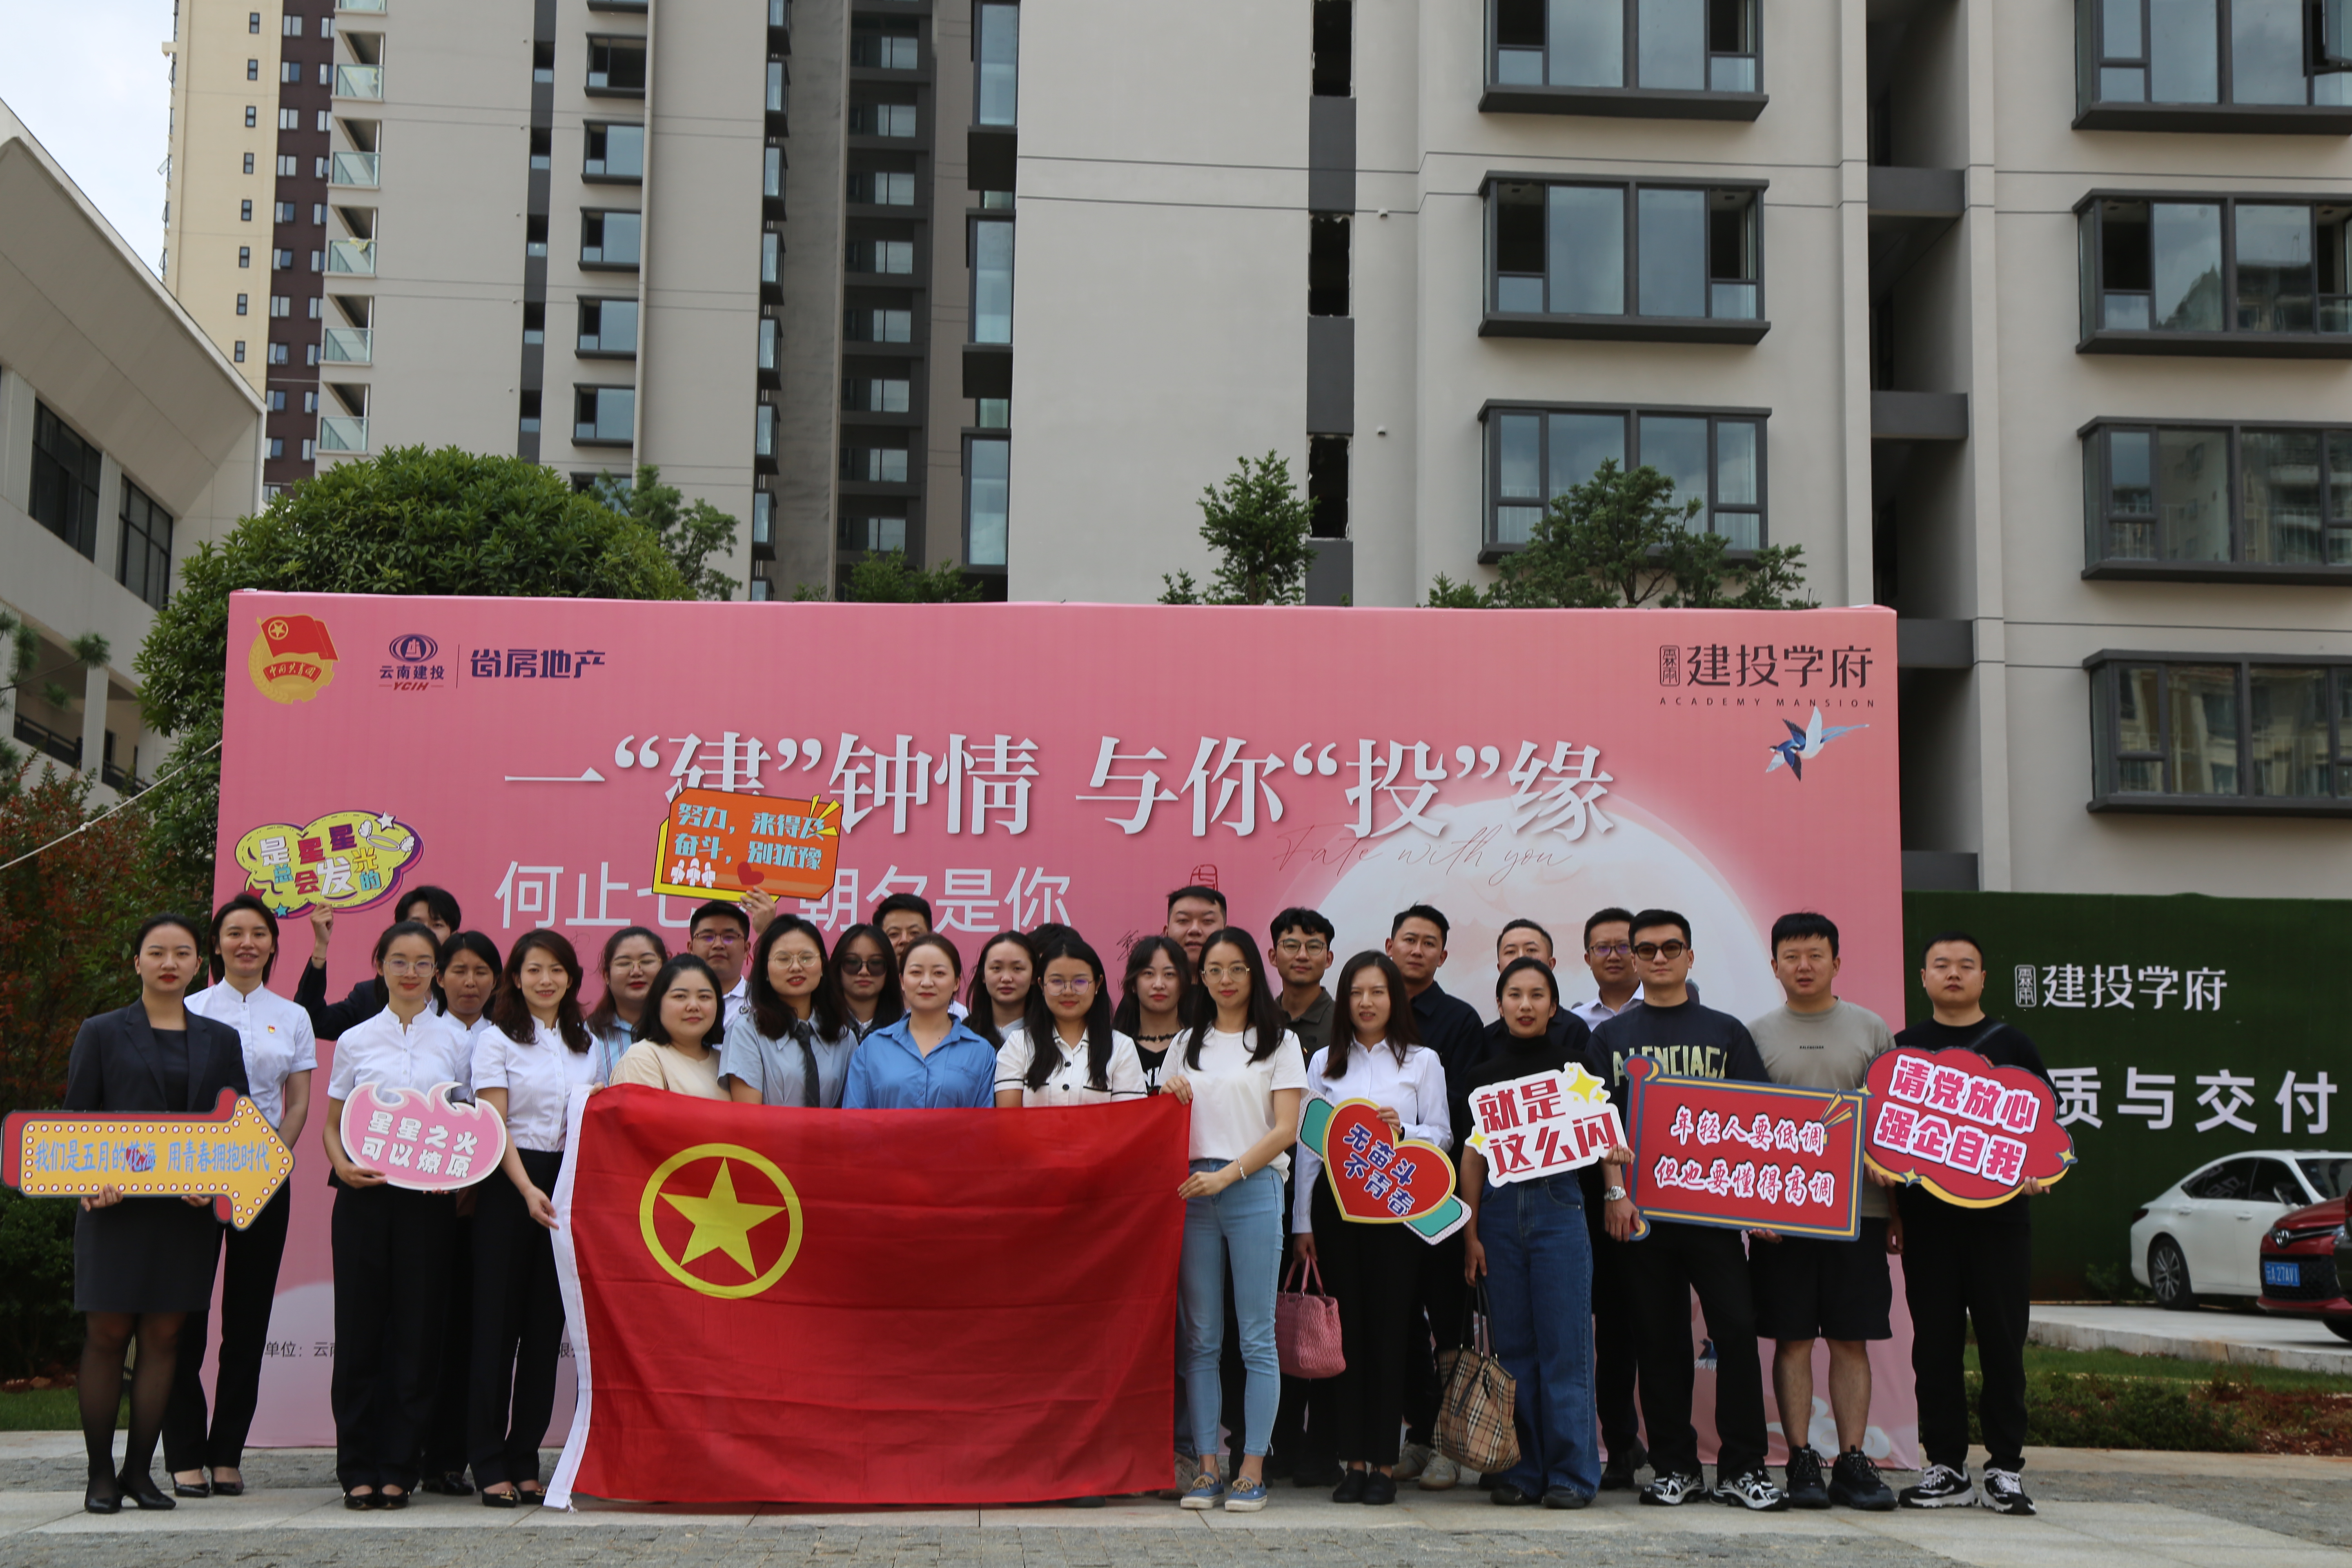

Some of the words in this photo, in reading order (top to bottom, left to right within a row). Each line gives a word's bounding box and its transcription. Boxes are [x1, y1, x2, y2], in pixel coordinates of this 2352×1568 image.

[379, 664, 445, 680] 云南建投
[393, 682, 429, 691] YCIH
[1686, 643, 1873, 688] 建投学府
[1660, 697, 1760, 706] ACADEMY
[1776, 698, 1874, 708] MANSION
[1272, 824, 1383, 877] Fate
[1398, 824, 1503, 876] with
[1488, 846, 1572, 887] you
[2042, 963, 2227, 1011] 建投学府
[1477, 1077, 1566, 1134] 就是
[1890, 1055, 2039, 1133] 请党放心
[2047, 1067, 2337, 1134] 质与交付
[368, 1109, 478, 1156] 星星之火
[1488, 1111, 1619, 1179] 这么闪
[1671, 1104, 1825, 1156] 年轻人要低调
[35, 1138, 157, 1173] 我们是五月的花海
[167, 1138, 270, 1174] 用青春拥抱时代
[361, 1136, 472, 1179] 可以燎原
[1655, 1155, 1835, 1207] 但也要懂得高调
